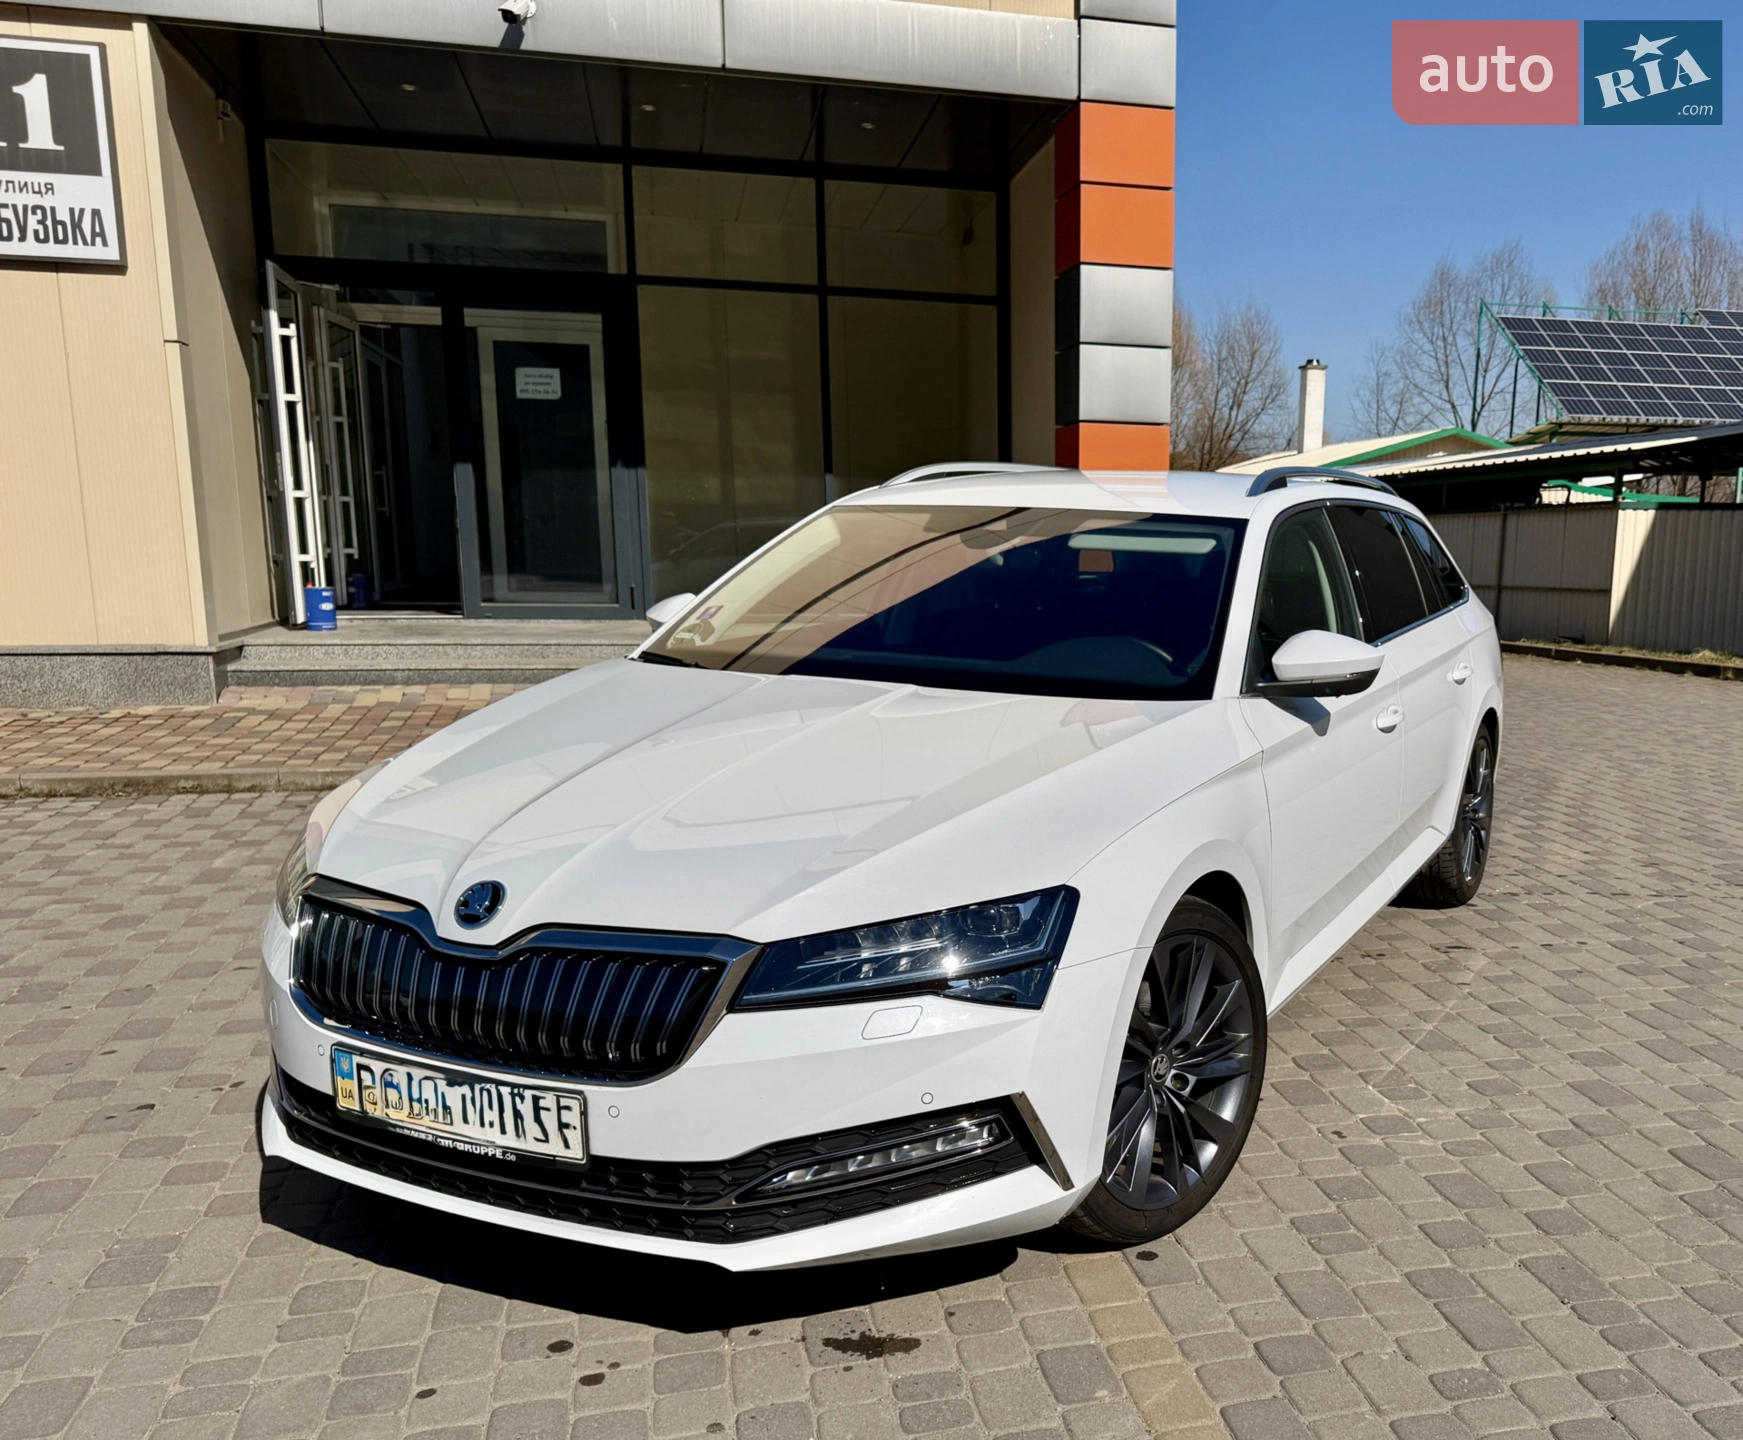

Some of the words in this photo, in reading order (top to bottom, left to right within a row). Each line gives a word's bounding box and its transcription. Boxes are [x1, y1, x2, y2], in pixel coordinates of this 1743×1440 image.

[0, 73, 65, 151] 1
[0, 179, 55, 198] лиця
[0, 202, 109, 248] БУЗЬКА
[340, 1086, 355, 1102] UA
